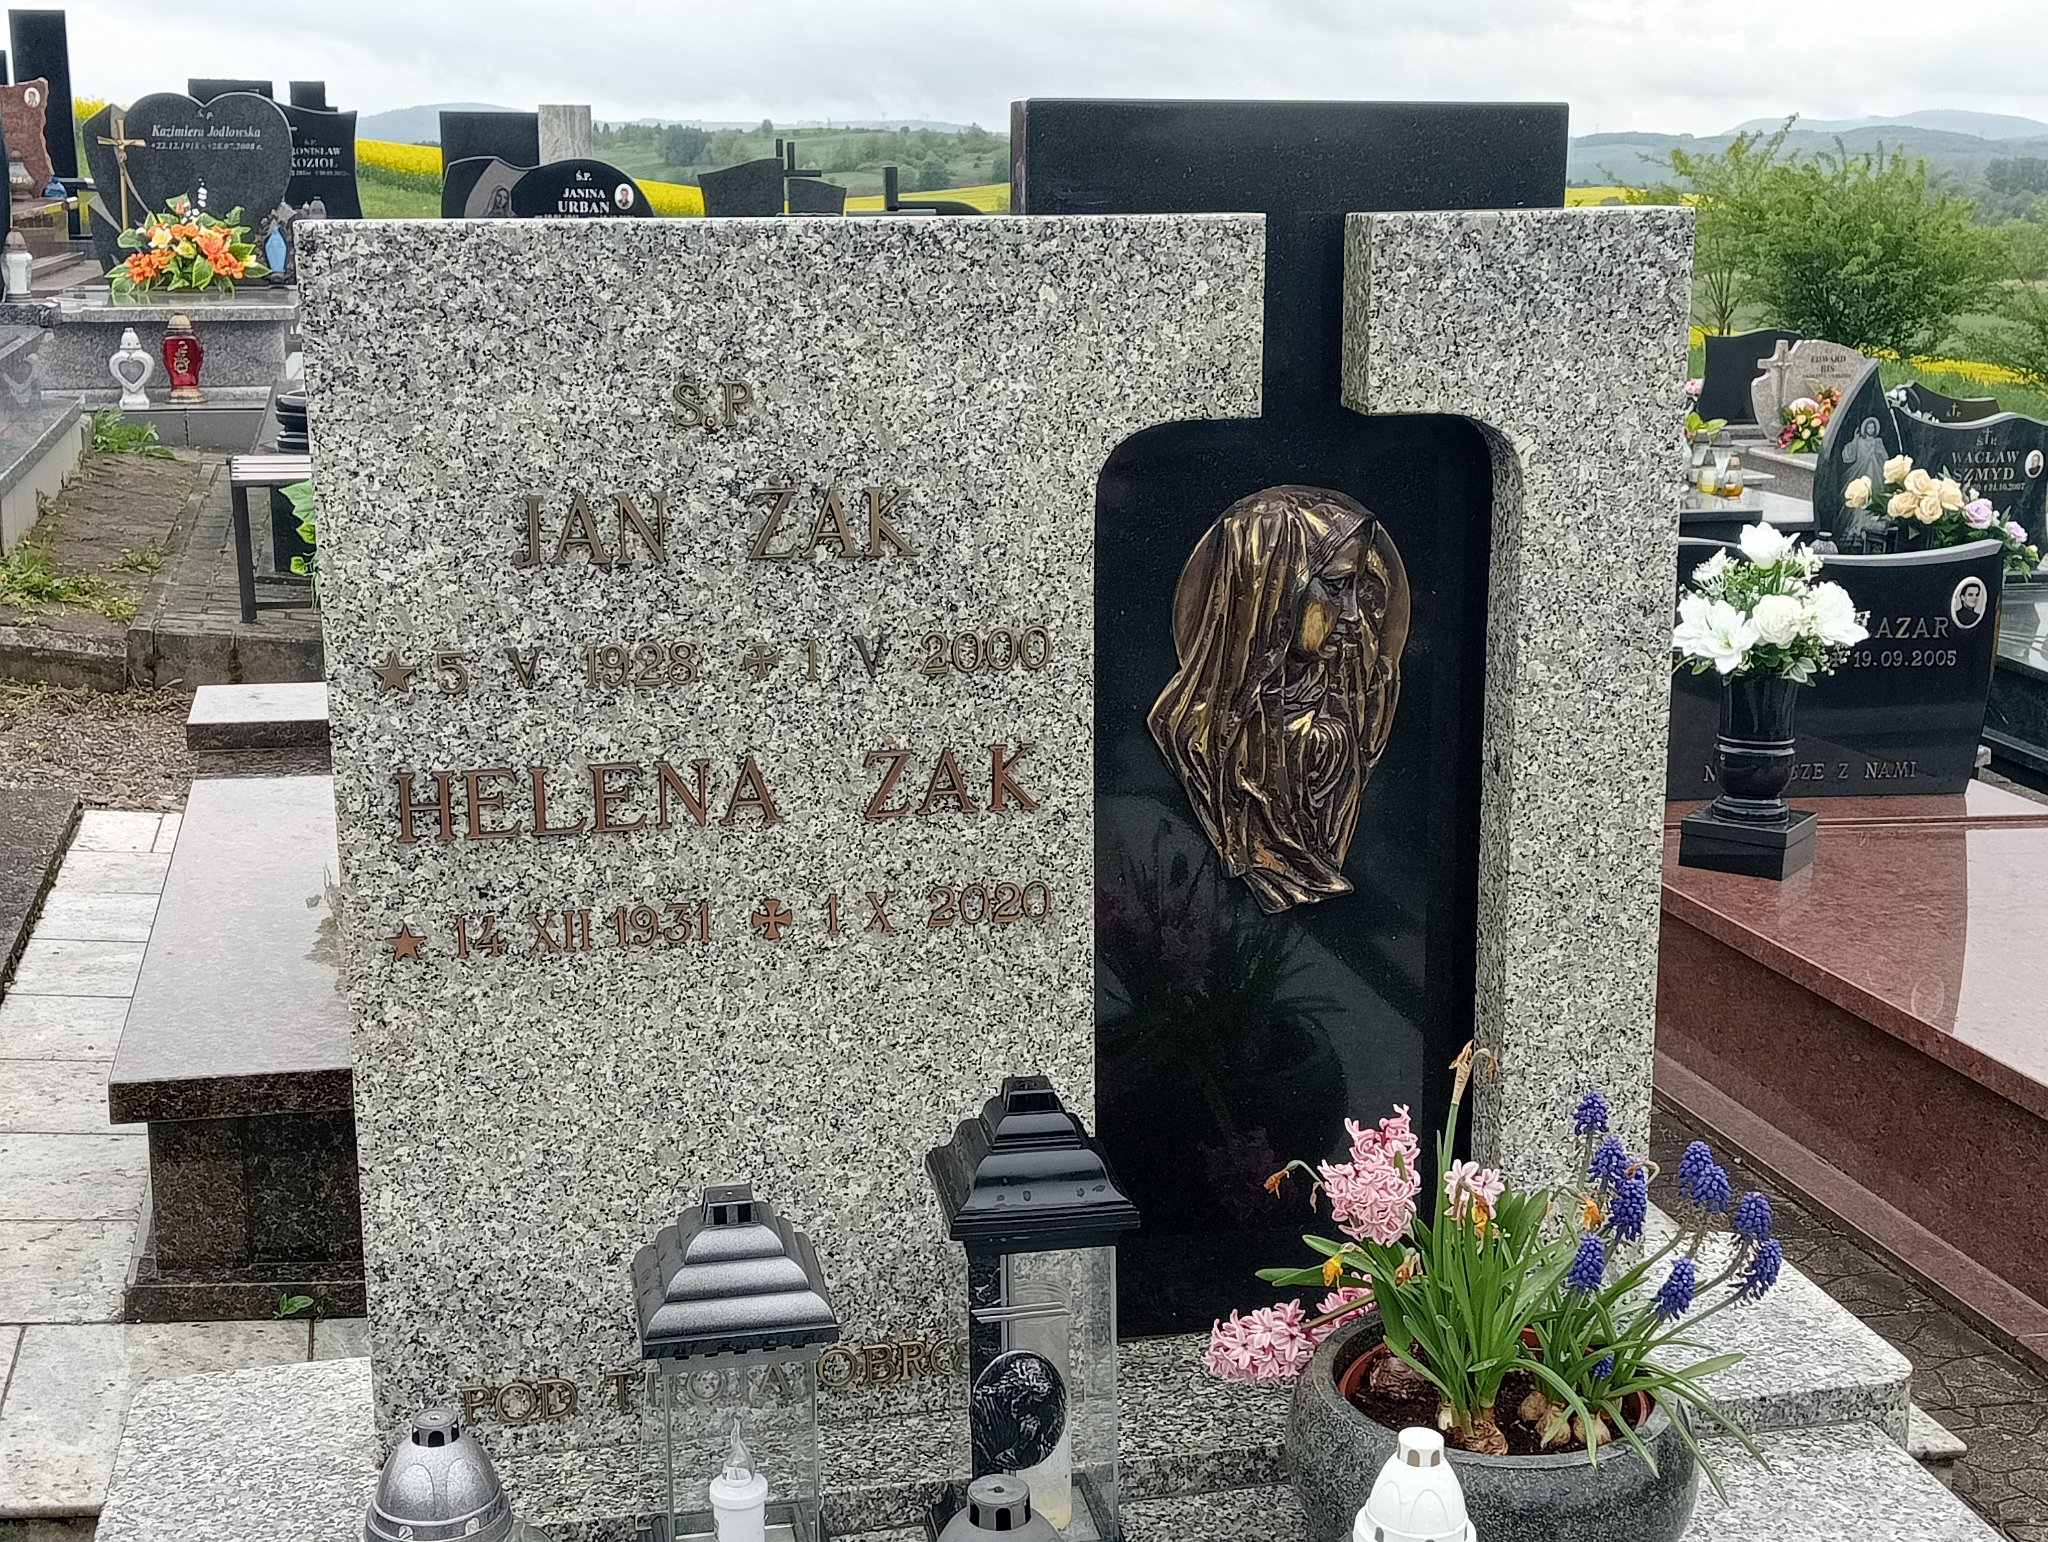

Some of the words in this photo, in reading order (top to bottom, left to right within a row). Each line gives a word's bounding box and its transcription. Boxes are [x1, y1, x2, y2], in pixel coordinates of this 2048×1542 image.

[151, 124, 204, 137] Kazimiera
[562, 188, 606, 199] JANINA
[557, 201, 610, 213] URBAN
[1953, 467, 2015, 481] SZMYD
[511, 492, 667, 567] JAN
[748, 472, 921, 562] ŻAK
[1868, 616, 1950, 639] AZAR
[436, 650, 469, 694] 5
[503, 645, 545, 689] V
[580, 641, 699, 689] 1928
[799, 636, 819, 682] 1
[852, 631, 887, 677] V
[920, 625, 1054, 676] 2000
[1853, 649, 1958, 669] 19.09.2005
[1838, 763, 1849, 779] Z
[1864, 761, 1917, 779] NAMI
[395, 754, 785, 845] HELENA
[862, 733, 1042, 821] ŻAK
[450, 914, 501, 960] 14
[526, 907, 593, 952] XII
[611, 899, 710, 948] 1931
[825, 893, 842, 938] 1
[865, 890, 896, 933] X
[926, 878, 1052, 928] 2020
[460, 1377, 578, 1426] POD
